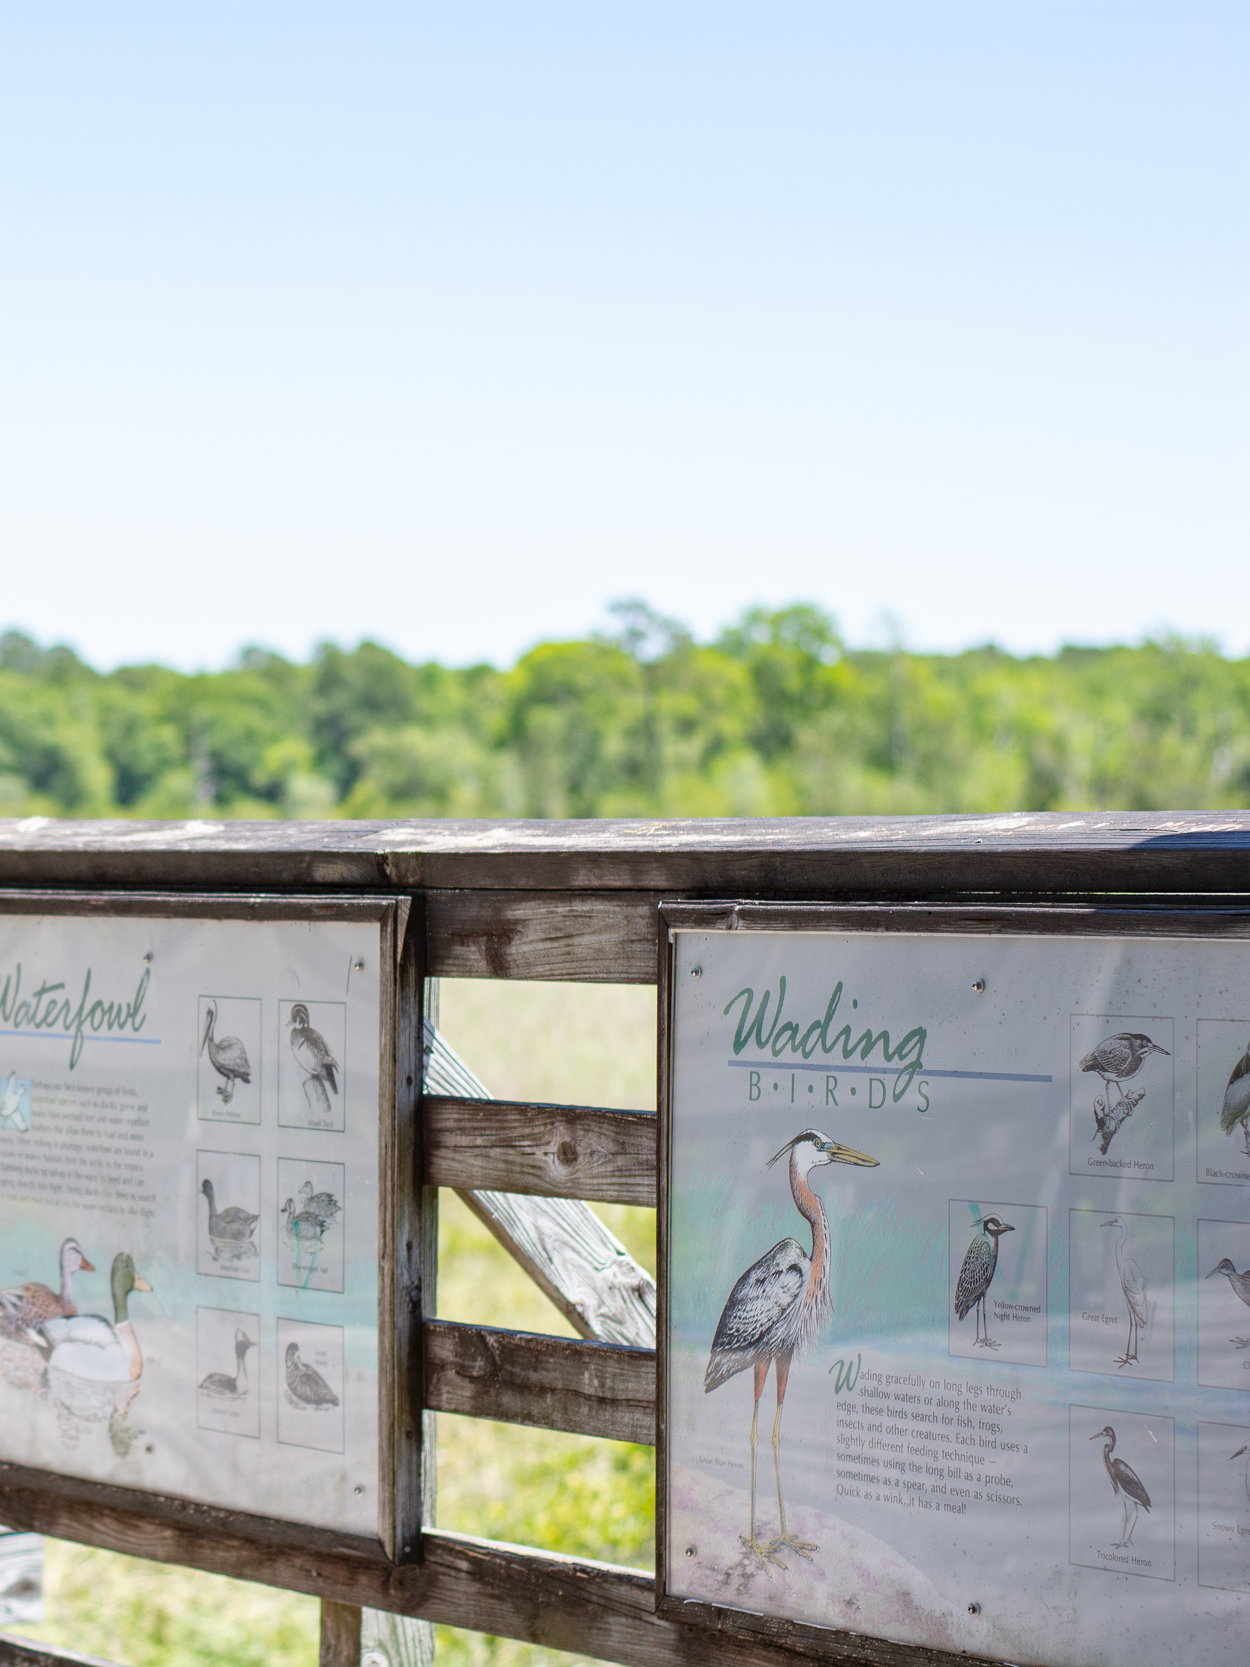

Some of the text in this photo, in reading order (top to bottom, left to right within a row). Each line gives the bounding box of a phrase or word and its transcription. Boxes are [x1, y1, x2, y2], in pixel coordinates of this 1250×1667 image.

[723, 975, 927, 1103] Wading
[97, 1088, 112, 1096] group
[323, 1120, 334, 1128] Duck
[1088, 1157, 1154, 1170] Green-backed Heron
[994, 1300, 1040, 1314] Yellow-crowned
[994, 1311, 1031, 1323] Night Heron
[1082, 1312, 1118, 1325] Great Egret
[860, 1383, 890, 1399] shallow
[894, 1389, 920, 1403] waters
[924, 1396, 933, 1405] or
[936, 1394, 959, 1414] along
[963, 1396, 977, 1411] the
[886, 1372, 925, 1392] gracefully
[929, 1380, 940, 1389] on
[944, 1377, 962, 1397] long
[966, 1380, 983, 1399] legs
[987, 1382, 1021, 1404] through
[837, 1398, 1003, 1437] edge, these birds search for fish, frogs,
[837, 1414, 1028, 1453] insects and other creatures. Each bird uses a
[837, 1431, 865, 1452] slightly
[869, 1435, 903, 1453] different
[907, 1441, 938, 1463] feeding
[942, 1446, 985, 1469] technique
[837, 1450, 1014, 1488] sometimes using the long bill as a probe,
[836, 1482, 966, 1514] Quick as a wink, it has a meal!
[837, 1468, 1022, 1506] sometimes as a spear, and even as scissors.
[1212, 1521, 1235, 1534] Snowy
[1097, 1551, 1152, 1567] Tricolored Heron
